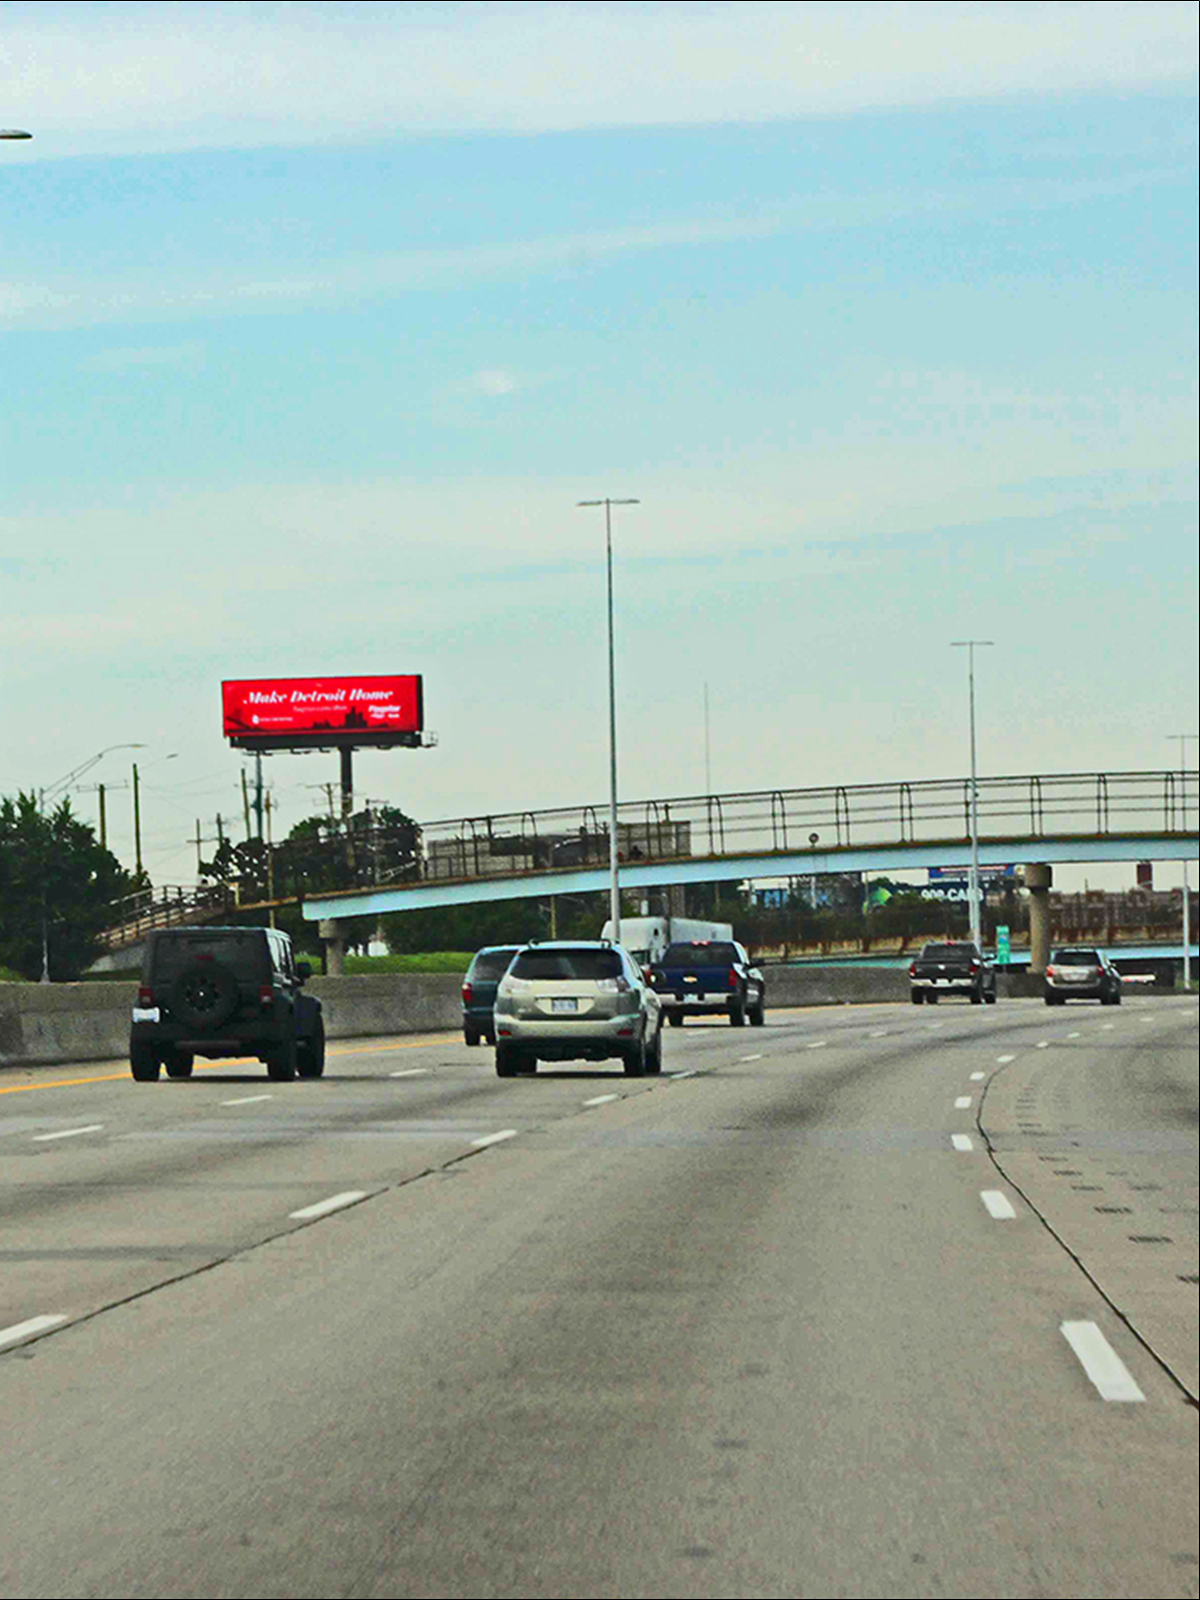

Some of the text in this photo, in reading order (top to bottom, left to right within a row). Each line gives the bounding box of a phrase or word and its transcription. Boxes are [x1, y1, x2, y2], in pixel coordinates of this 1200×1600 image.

[243, 688, 394, 704] Make Detroit Home
